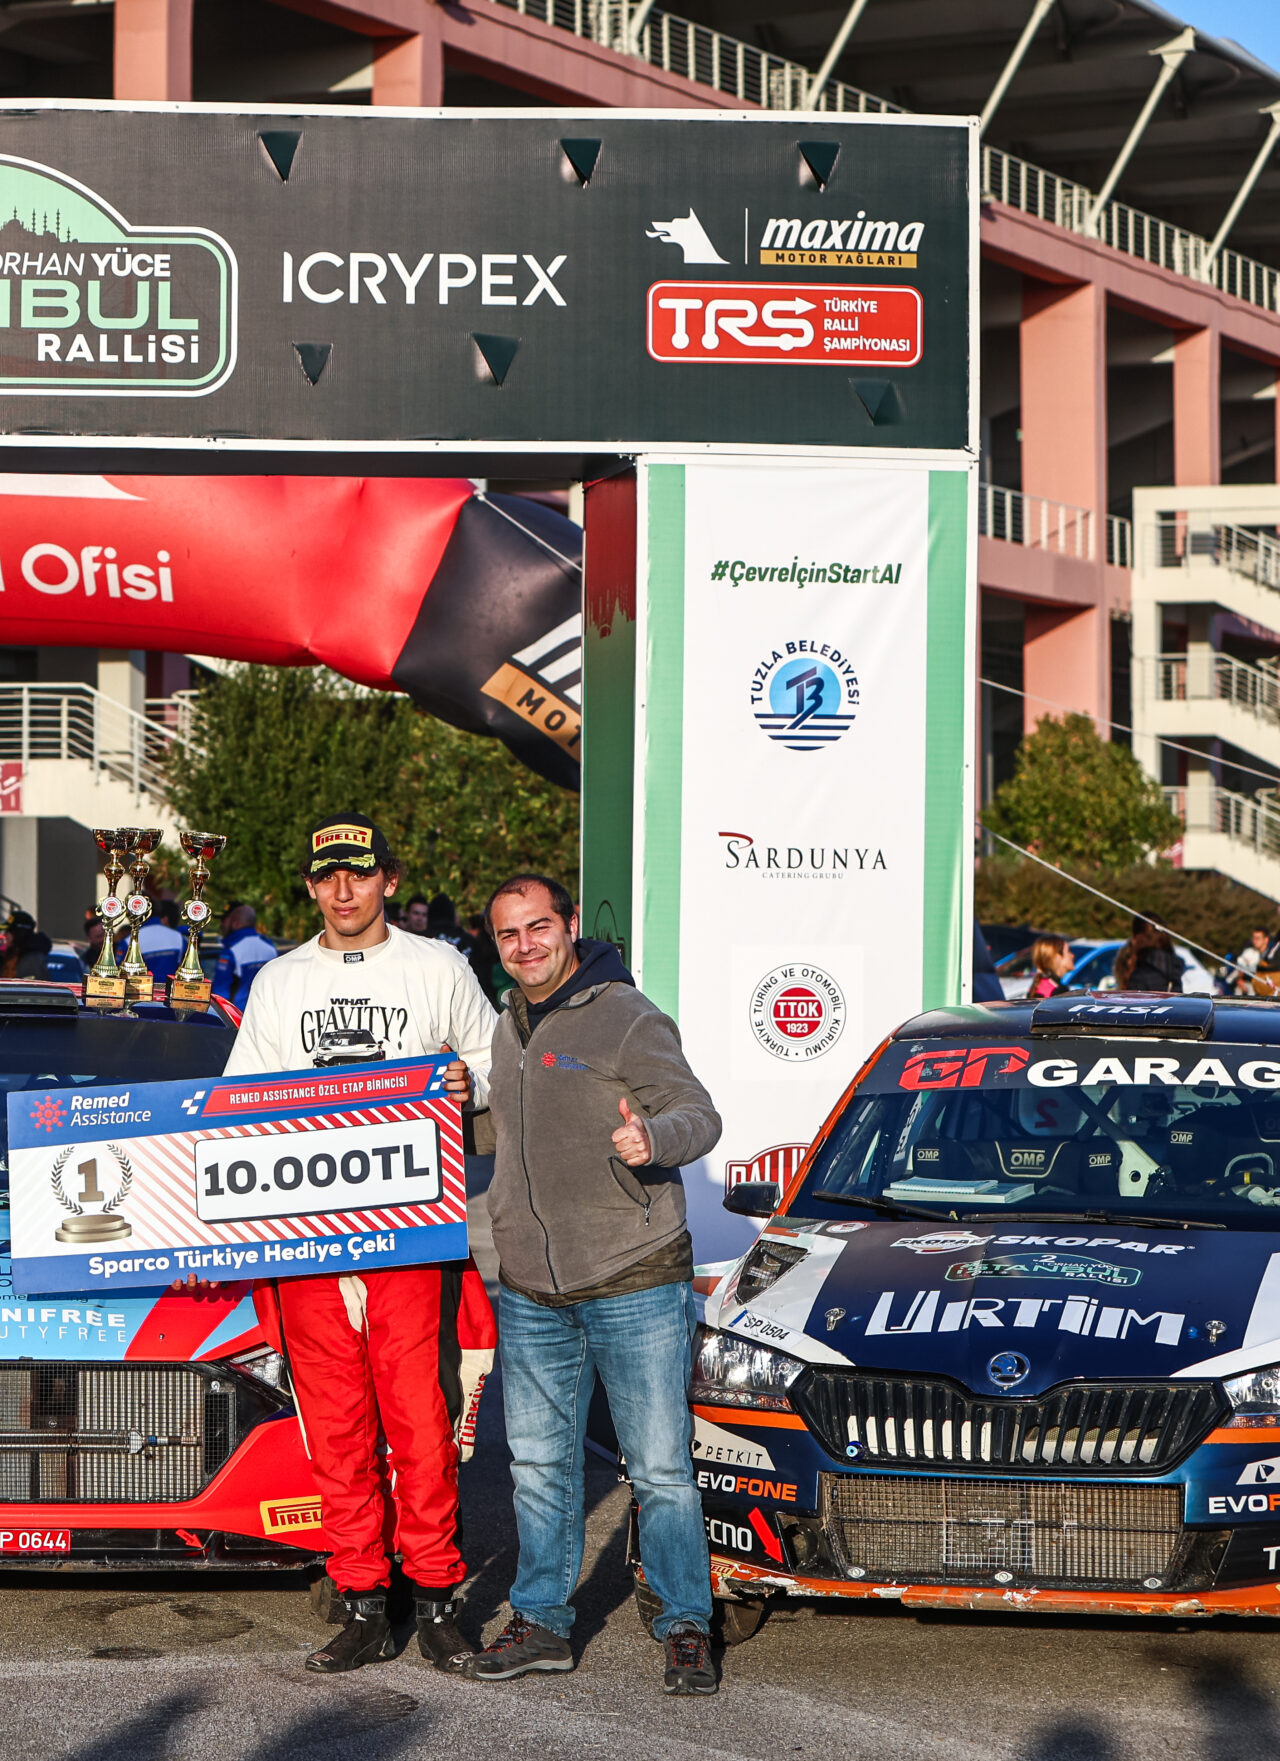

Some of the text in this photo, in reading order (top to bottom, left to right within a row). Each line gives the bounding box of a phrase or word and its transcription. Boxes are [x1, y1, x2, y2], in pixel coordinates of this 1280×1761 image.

[760, 210, 926, 253] maxima
[91, 247, 171, 278] YÜCE
[775, 252, 903, 266] MOTOR YAĞLARI
[283, 251, 567, 307] ICRYPEX
[823, 297, 878, 314] TÜRKİYE
[658, 297, 817, 351] TRS
[823, 316, 859, 332] RALLİ
[823, 335, 911, 354] ŞAMPİYONASI
[20, 542, 174, 603] Ofisi
[750, 649, 783, 705] TUZLA
[315, 829, 367, 847] PIRELLI
[724, 840, 888, 870] SARDUNYA
[329, 998, 371, 1006] WHAT
[777, 1001, 819, 1017] TTOK
[781, 968, 795, 979] VE
[805, 1018, 841, 1057] KURUMU
[786, 1023, 808, 1033] 1923
[229, 1075, 408, 1104] REMED ASSISTANCE ÖZEL ETAP BİRİNCİSİ
[70, 1092, 131, 1111] Remed
[70, 1108, 152, 1127] Assistance
[1170, 1132, 1193, 1143] OMP
[917, 1150, 939, 1159] OMP
[1010, 1153, 1045, 1166] OMP
[1089, 1155, 1111, 1165] OMP
[77, 1157, 105, 1202] 1
[204, 1144, 430, 1197] 10.000TL
[992, 1235, 1187, 1255] SKOPAR
[88, 1234, 396, 1278] Sparco Türkiye Hediye Çeki
[760, 1322, 790, 1340] 0504
[705, 1445, 763, 1467] PETKIT
[697, 1470, 798, 1502] EVOFONE
[18, 1532, 67, 1549] 0644
